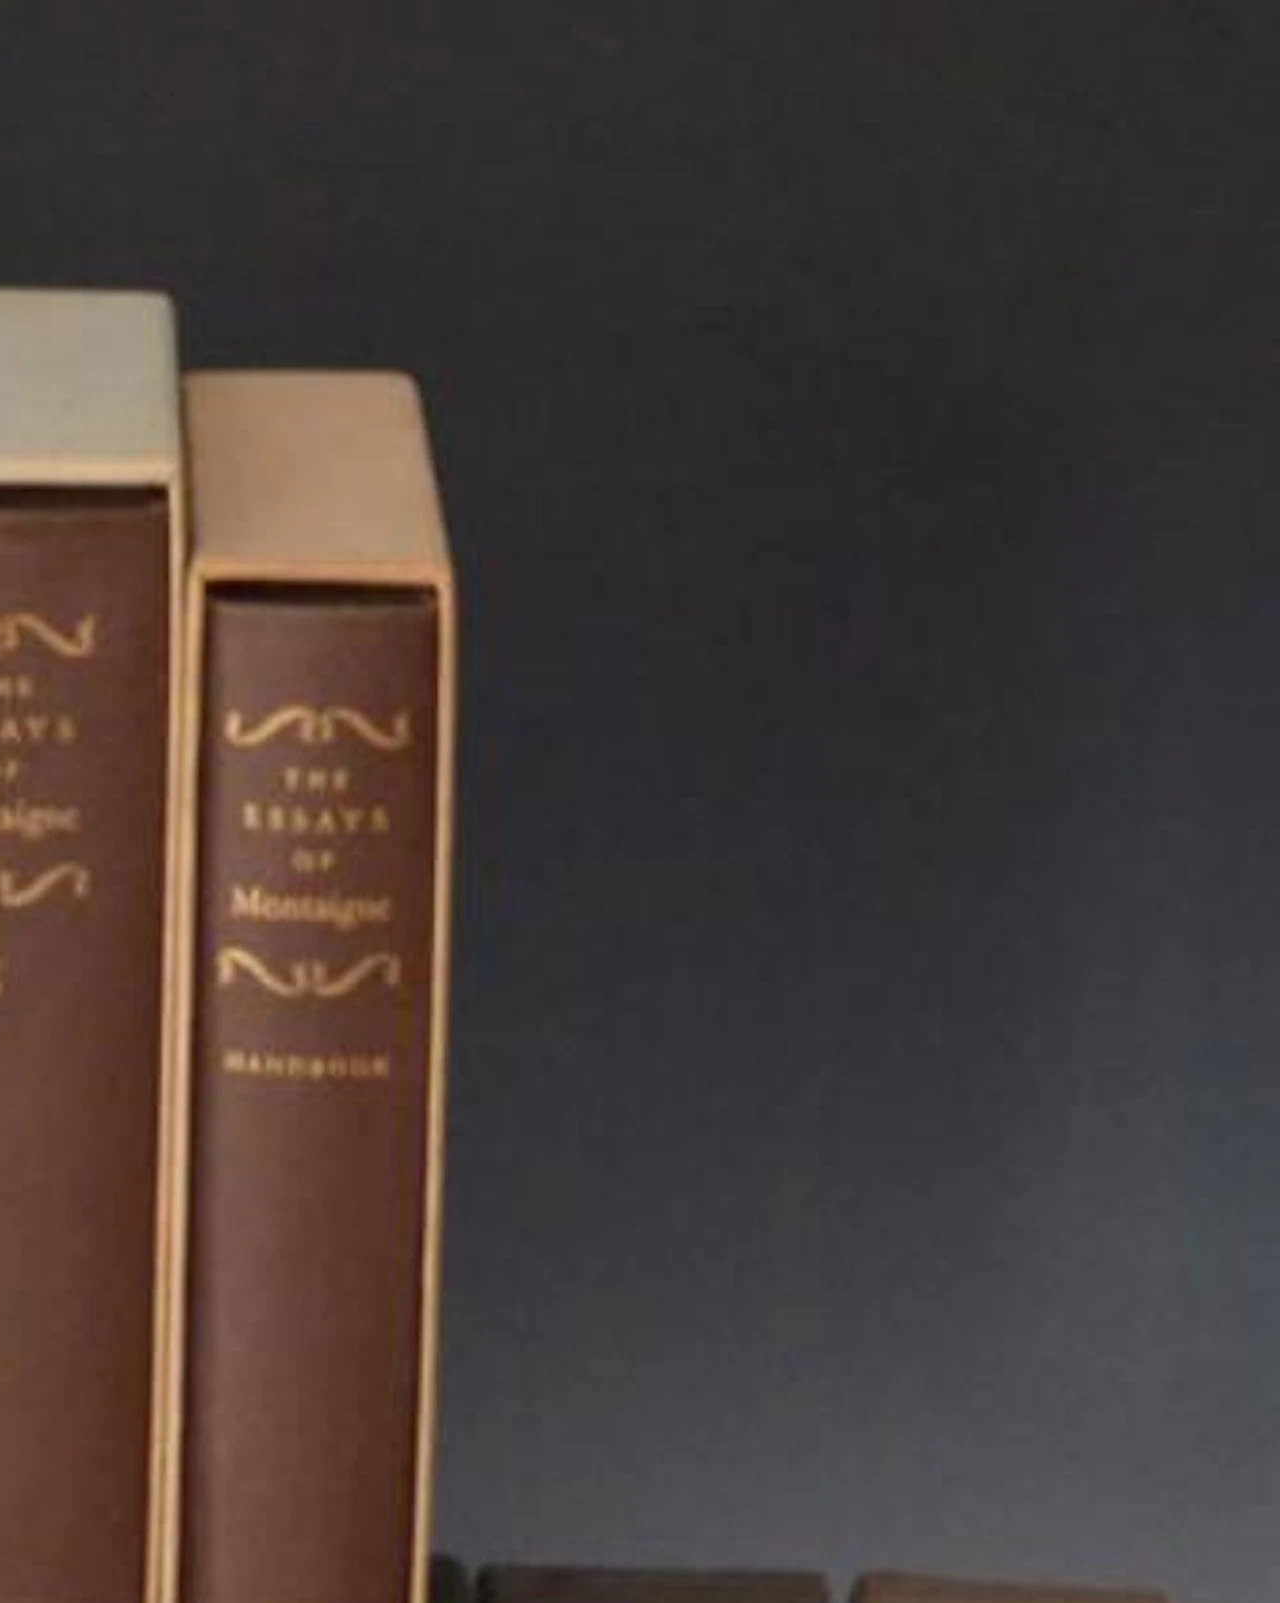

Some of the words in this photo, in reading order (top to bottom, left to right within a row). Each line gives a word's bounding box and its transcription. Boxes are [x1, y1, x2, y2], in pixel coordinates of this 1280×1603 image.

[283, 768, 350, 790] THE
[243, 805, 389, 832] ESSAYS
[293, 850, 335, 872] OF
[231, 887, 390, 927] Montaigne
[221, 1052, 390, 1078] HANDBOOK
